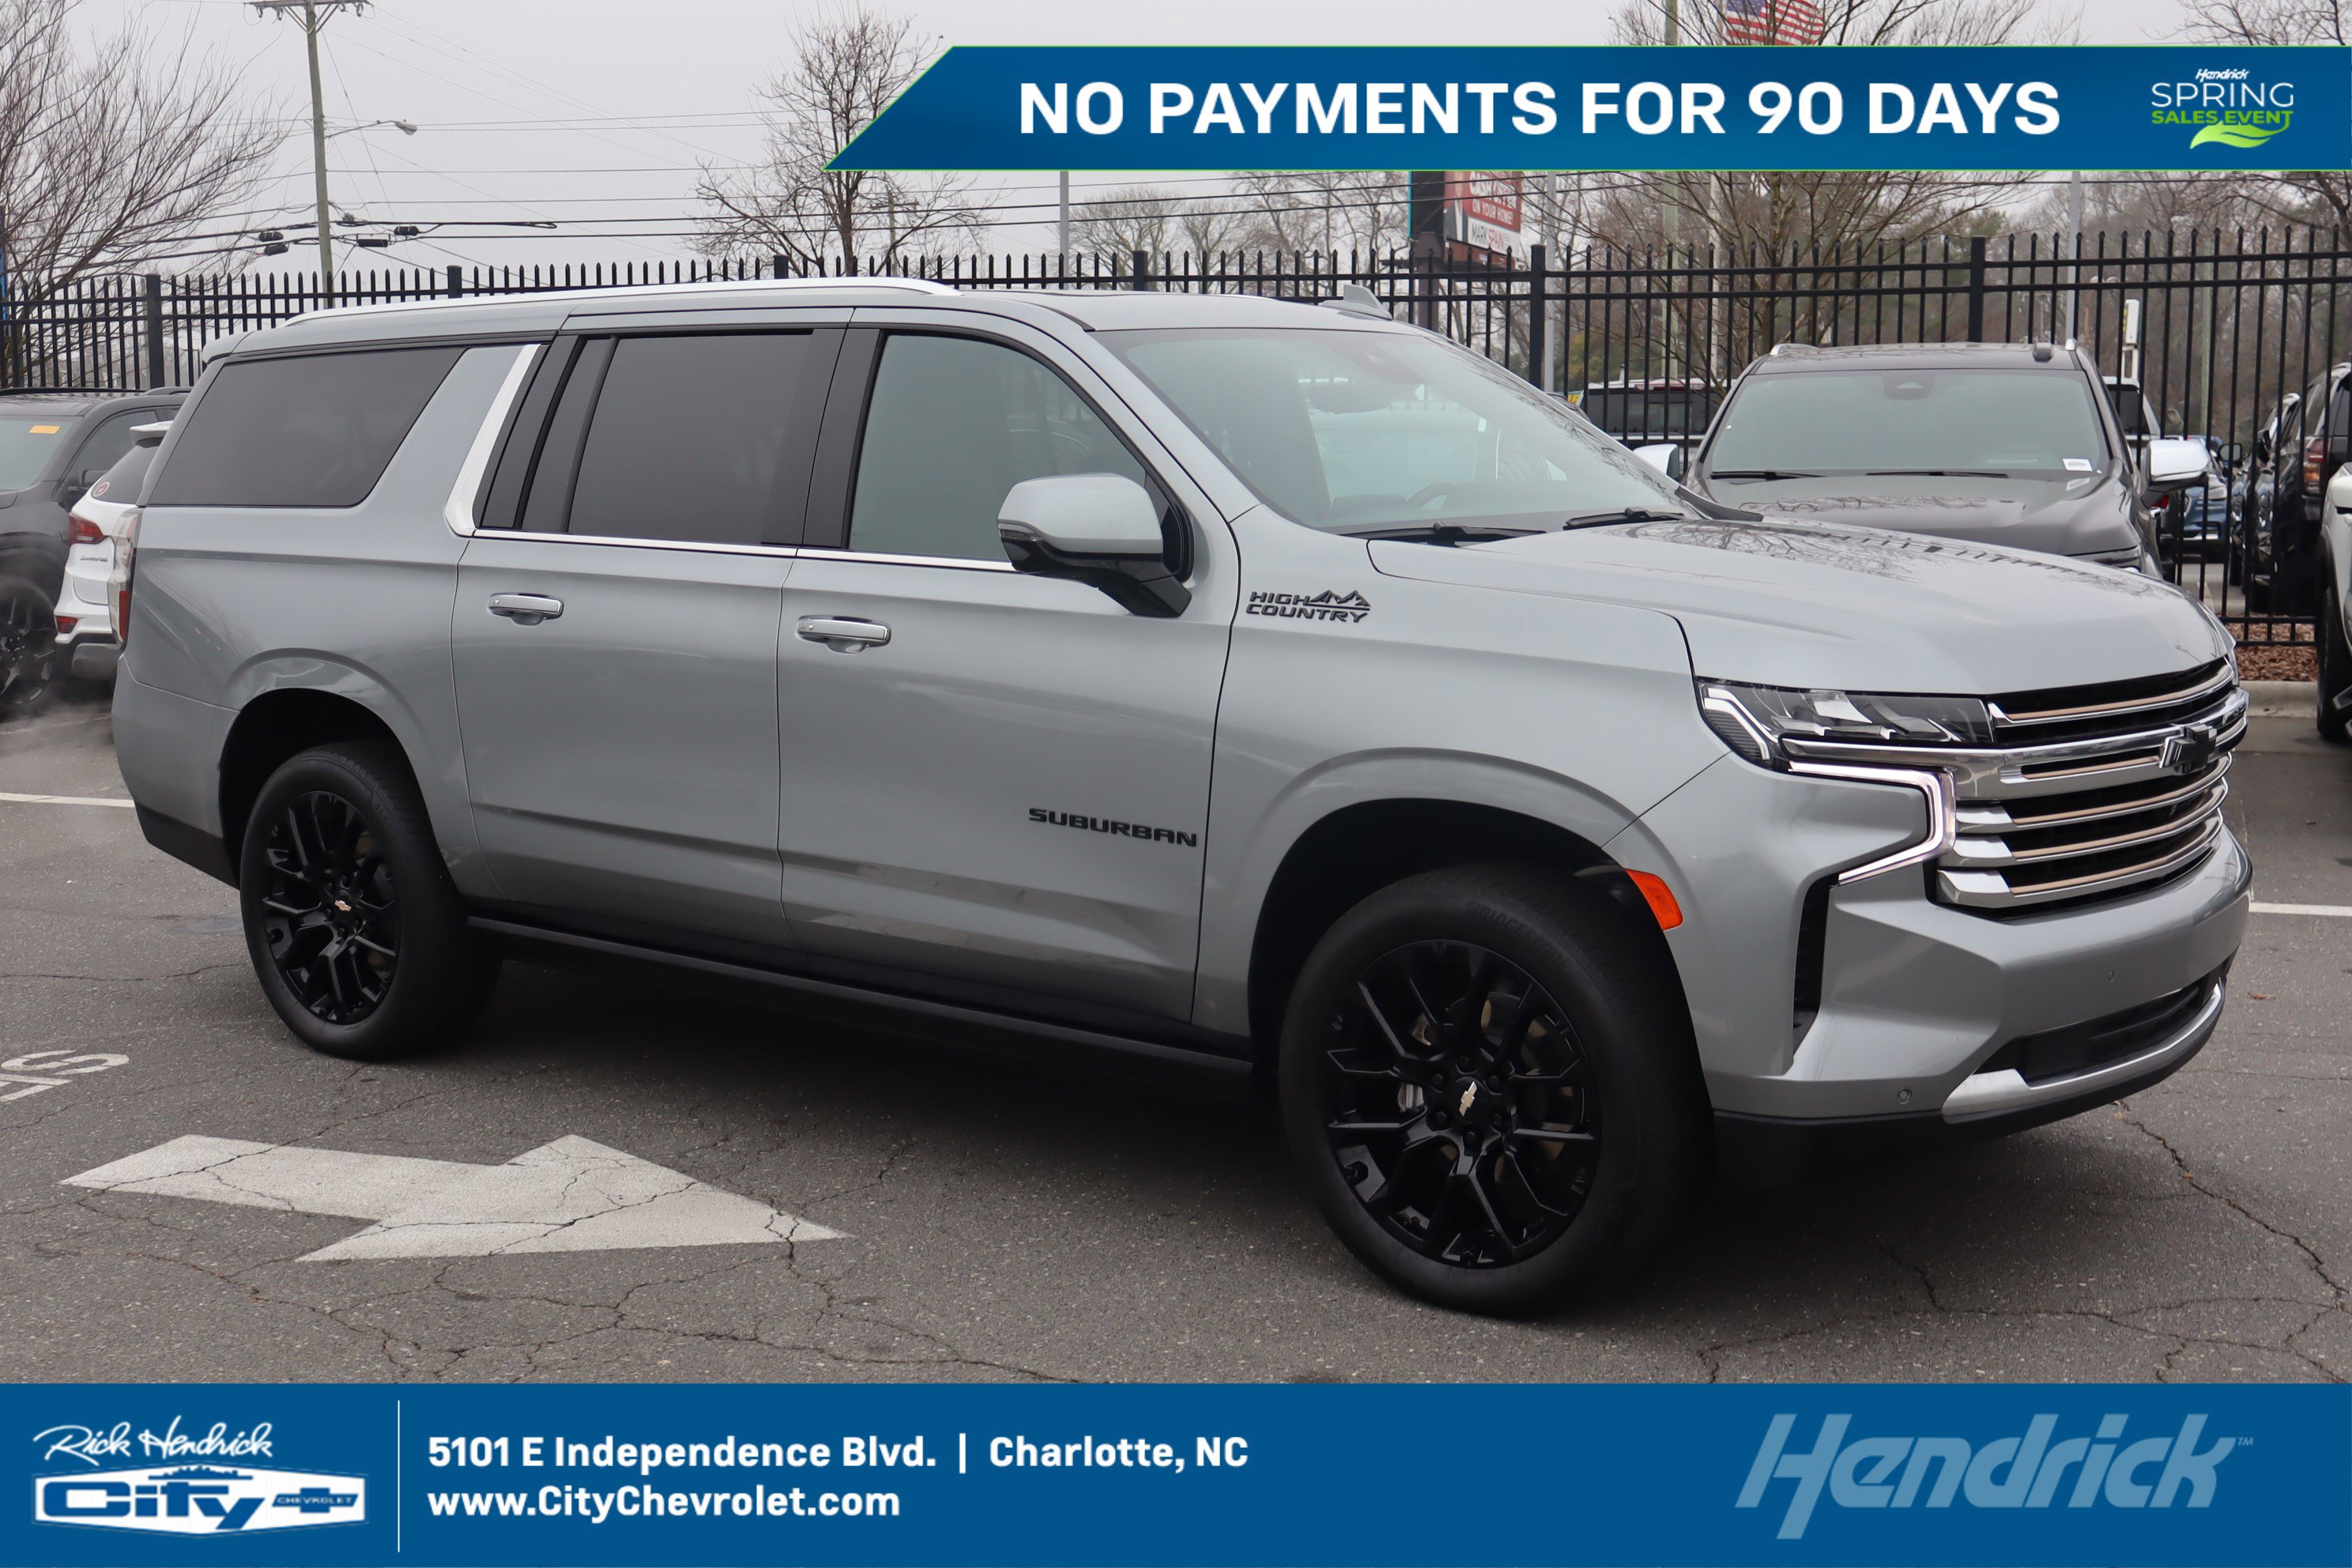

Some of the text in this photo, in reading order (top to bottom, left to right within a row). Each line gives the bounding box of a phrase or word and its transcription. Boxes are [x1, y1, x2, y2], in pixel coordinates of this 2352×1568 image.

[1249, 591, 1311, 605] HIGH
[1245, 603, 1369, 624] COUNTRY
[1028, 807, 1197, 847] SUBURBAN
